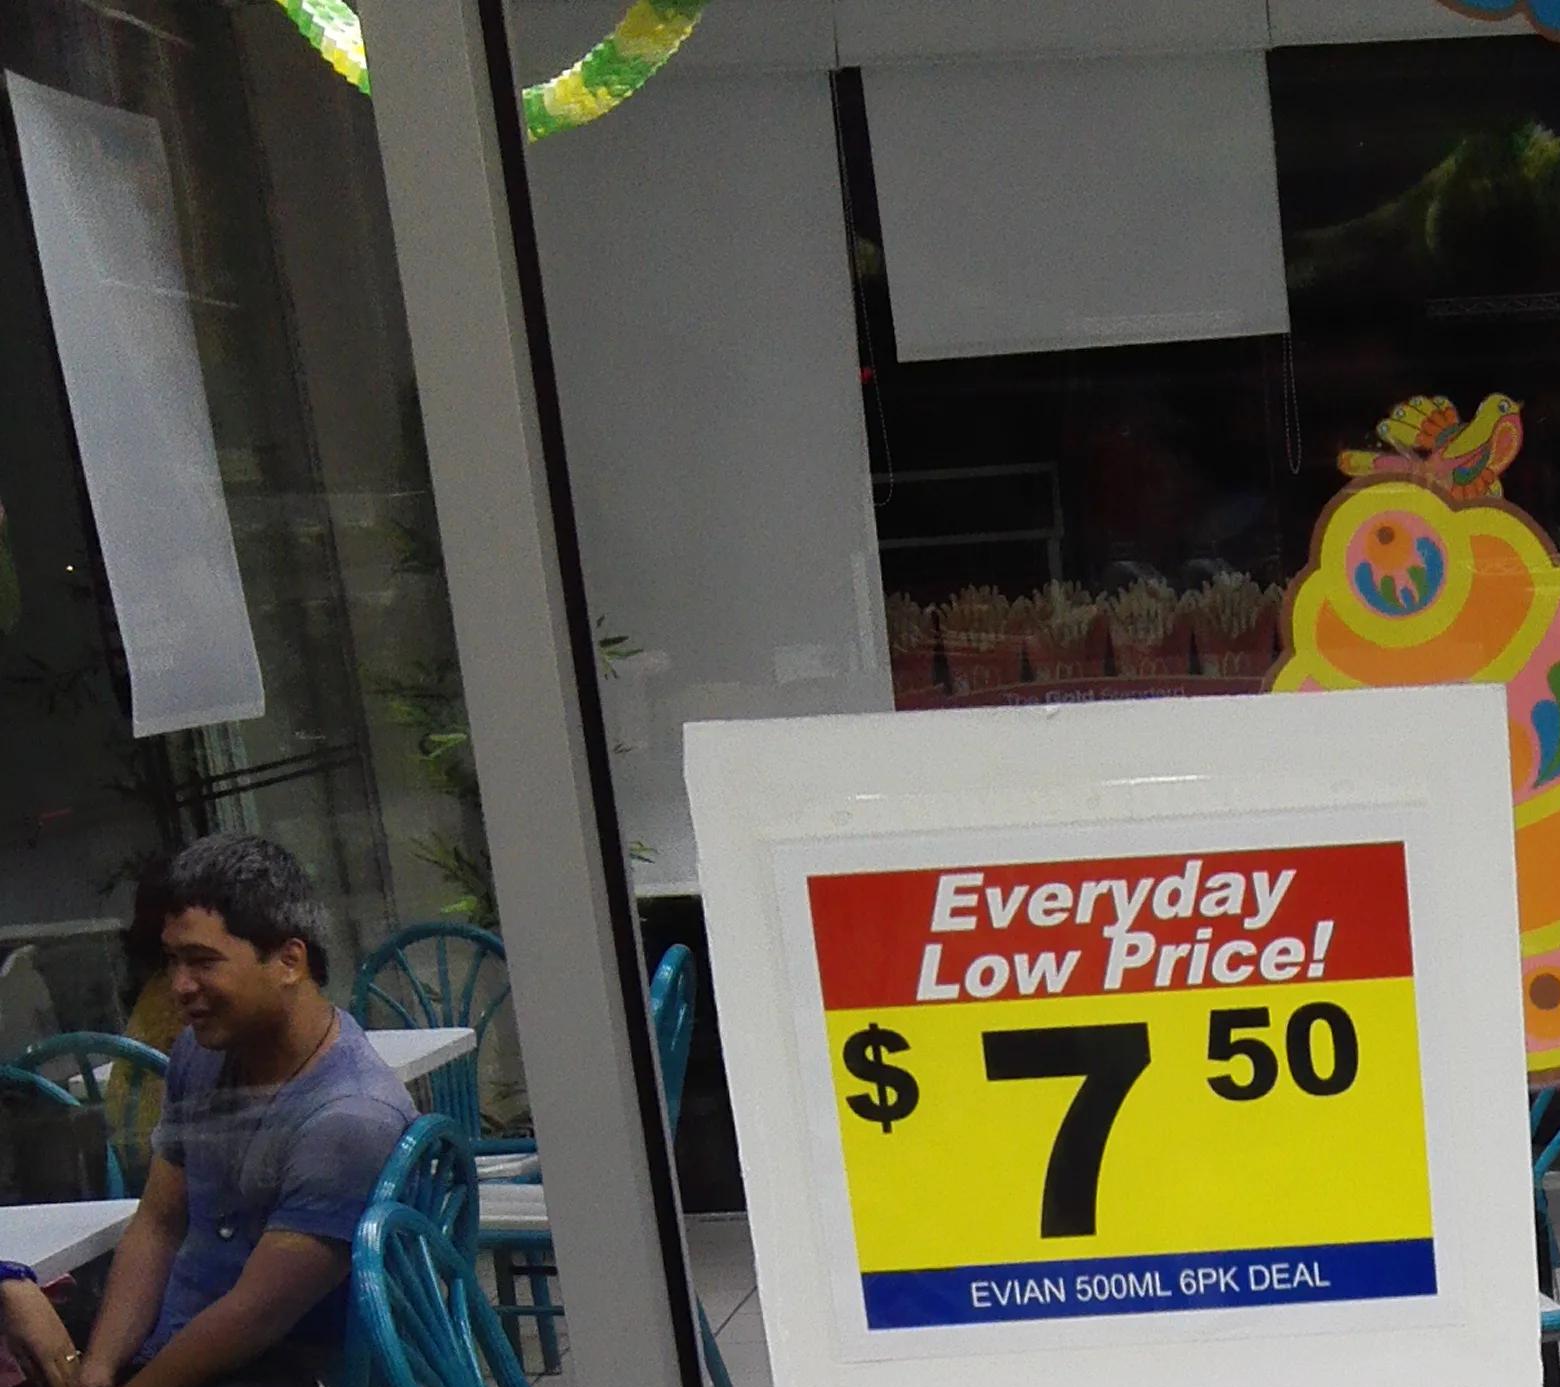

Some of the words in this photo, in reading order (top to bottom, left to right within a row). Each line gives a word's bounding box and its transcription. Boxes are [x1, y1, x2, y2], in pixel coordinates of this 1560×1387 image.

[931, 858, 1296, 938] Everyday
[916, 943, 1082, 1002] Low
[1102, 919, 1335, 993] Price!
[842, 1022, 920, 1133] $
[982, 1022, 1151, 1239] 7
[1206, 1001, 1360, 1102] 50
[971, 1276, 1067, 1308] EVIAN
[1076, 1271, 1171, 1302] 500ML
[1180, 1266, 1240, 1296] 6PK
[1248, 1261, 1331, 1292] DEAL
